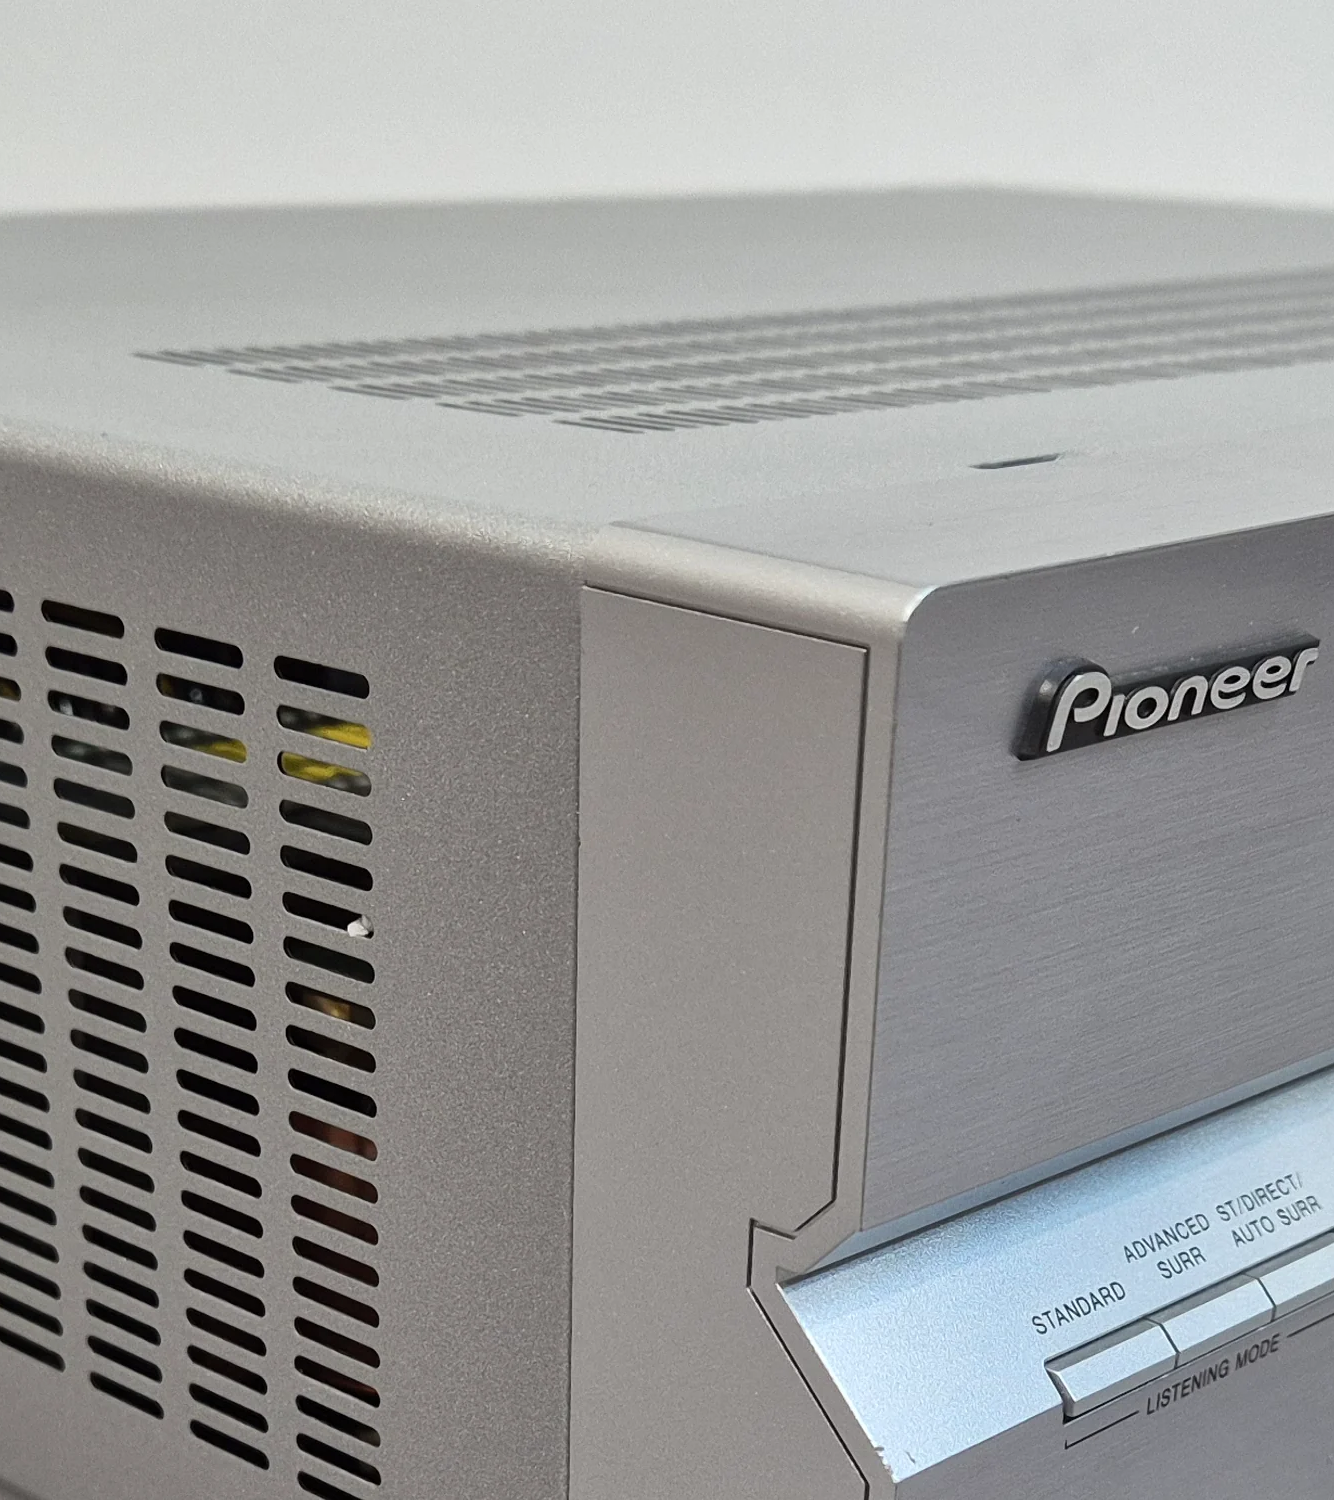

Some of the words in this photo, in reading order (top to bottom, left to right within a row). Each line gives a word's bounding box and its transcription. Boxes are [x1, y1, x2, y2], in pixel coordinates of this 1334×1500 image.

[1046, 647, 1320, 752] Pioneer
[1123, 1212, 1210, 1263] ADVANCED
[1231, 1217, 1275, 1248] AUTO
[1277, 1195, 1323, 1228] SURR
[1156, 1246, 1206, 1281] SURR
[1031, 1281, 1125, 1335] STANDARD
[1146, 1361, 1229, 1416] LISTENING
[1234, 1334, 1281, 1374] MODE
